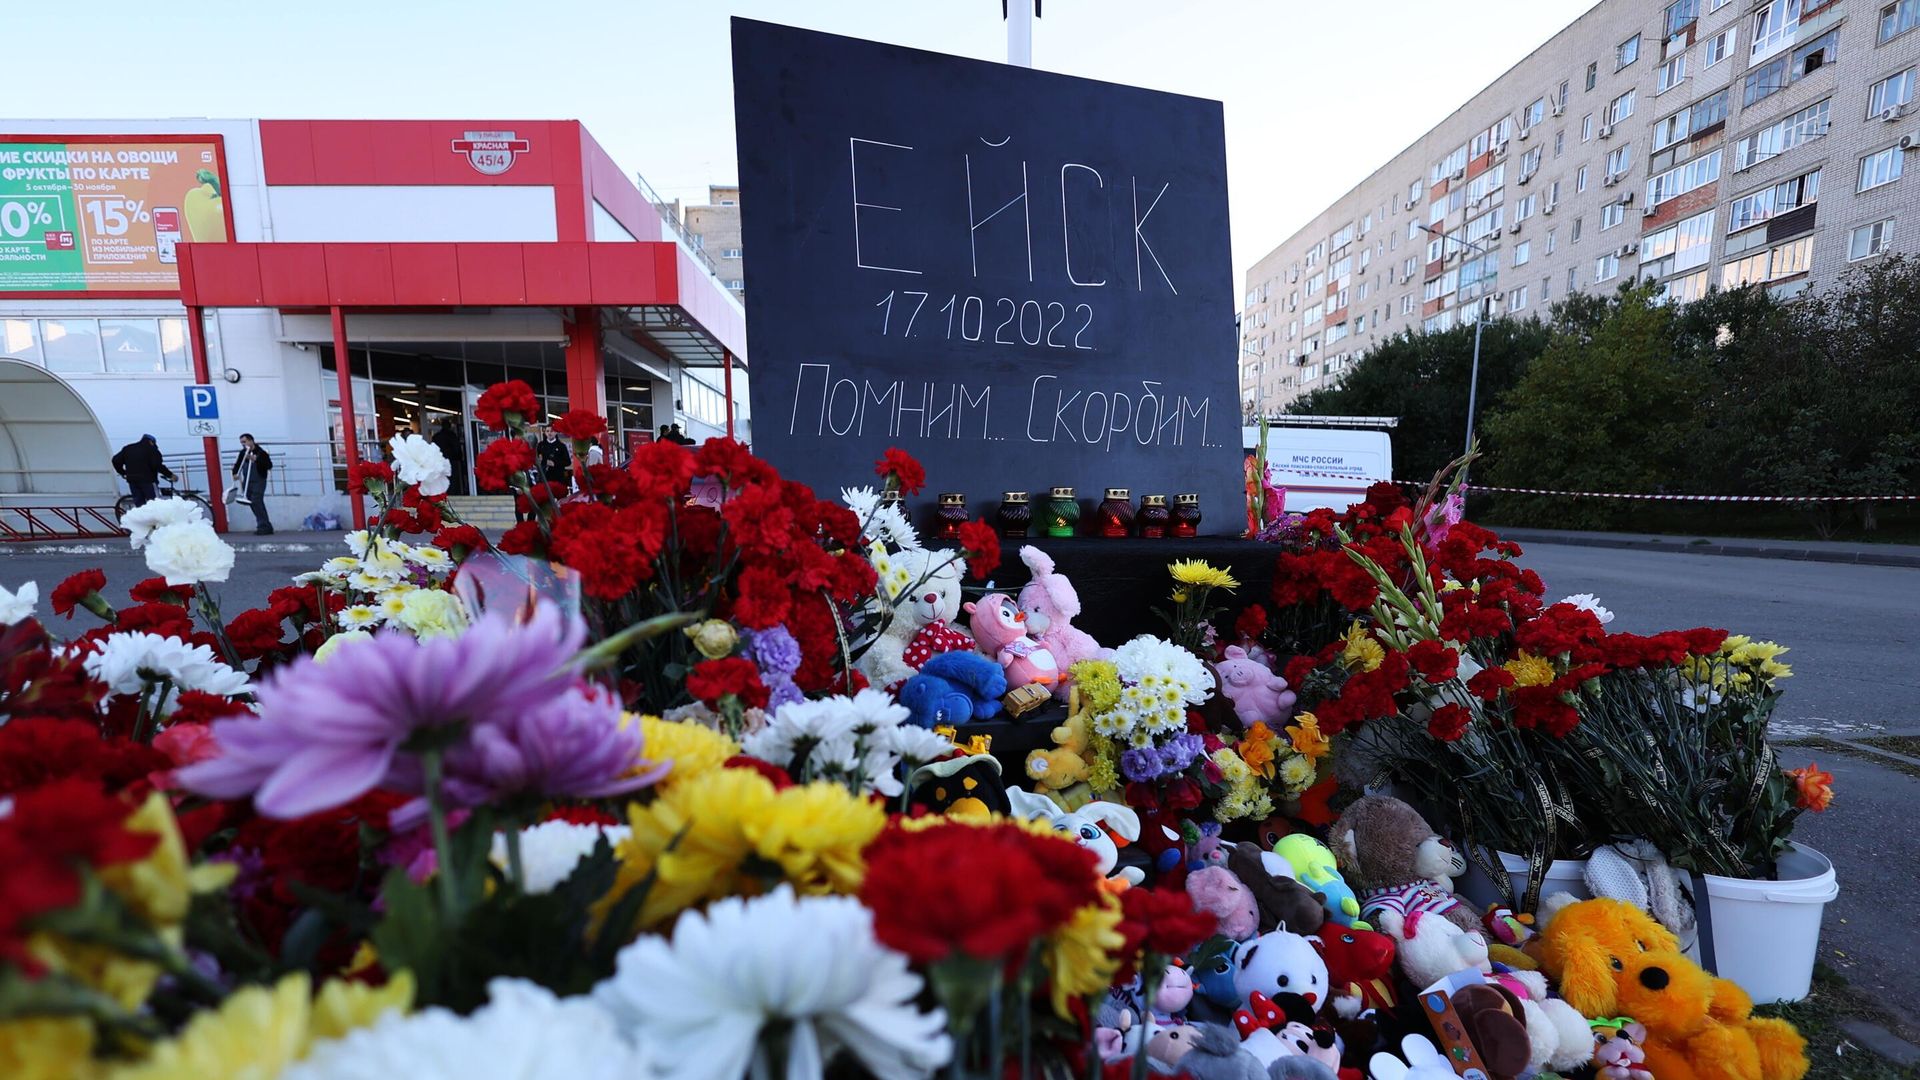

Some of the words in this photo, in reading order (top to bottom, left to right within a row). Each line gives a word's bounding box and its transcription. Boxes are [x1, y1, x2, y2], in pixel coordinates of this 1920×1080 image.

[472, 142, 509, 150] КРАСНАЯ
[23, 151, 88, 165] СКИДКИ
[91, 151, 114, 163] НА
[117, 151, 178, 165] ОВОЩИ
[477, 154, 504, 167] 45/4
[2, 167, 71, 181] ФРУКТЫ
[73, 168, 97, 180] ПО
[99, 168, 150, 180] КАРТЕ
[33, 183, 67, 192] октября
[73, 183, 84, 191] 30
[86, 183, 117, 192] ноября
[0, 201, 52, 238] 0%
[86, 200, 150, 236] 15%
[850, 135, 1178, 295] ЕЙСК
[192, 388, 212, 416] P
[1292, 455, 1310, 463] МЧС
[1311, 456, 1344, 465] РОССИИ
